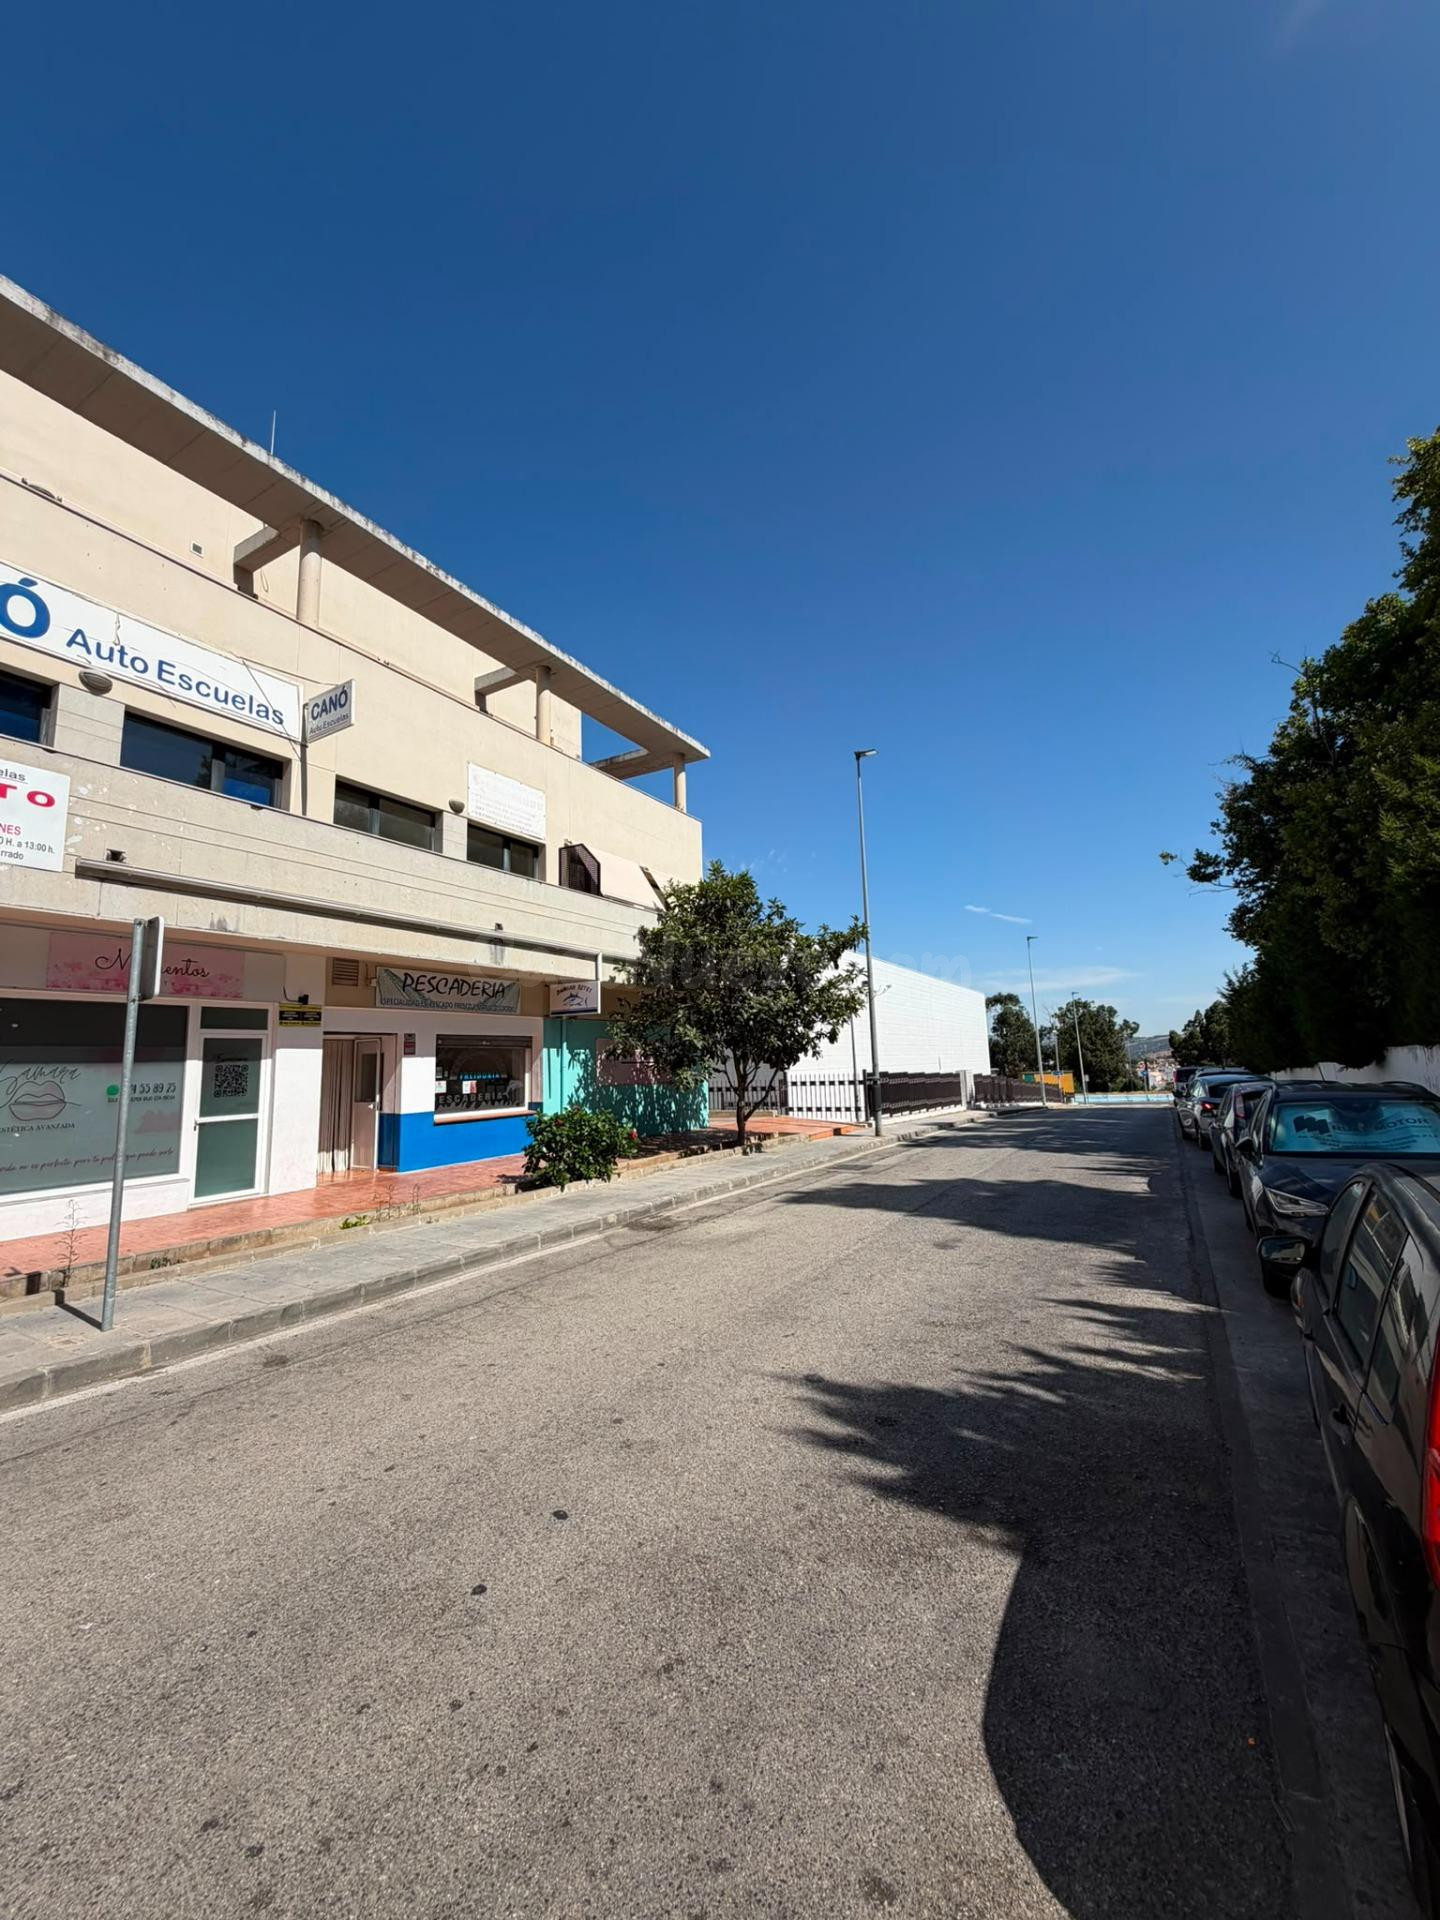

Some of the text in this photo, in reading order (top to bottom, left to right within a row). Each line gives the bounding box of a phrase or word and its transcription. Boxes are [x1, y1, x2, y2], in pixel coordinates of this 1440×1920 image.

[66, 628, 149, 674] Auto
[157, 659, 285, 725] Escuelas
[311, 685, 348, 720] CANÓ
[95, 947, 210, 977] Mentos
[402, 972, 506, 999] PESCADERIA
[438, 1092, 503, 1104] ESCADERIA
